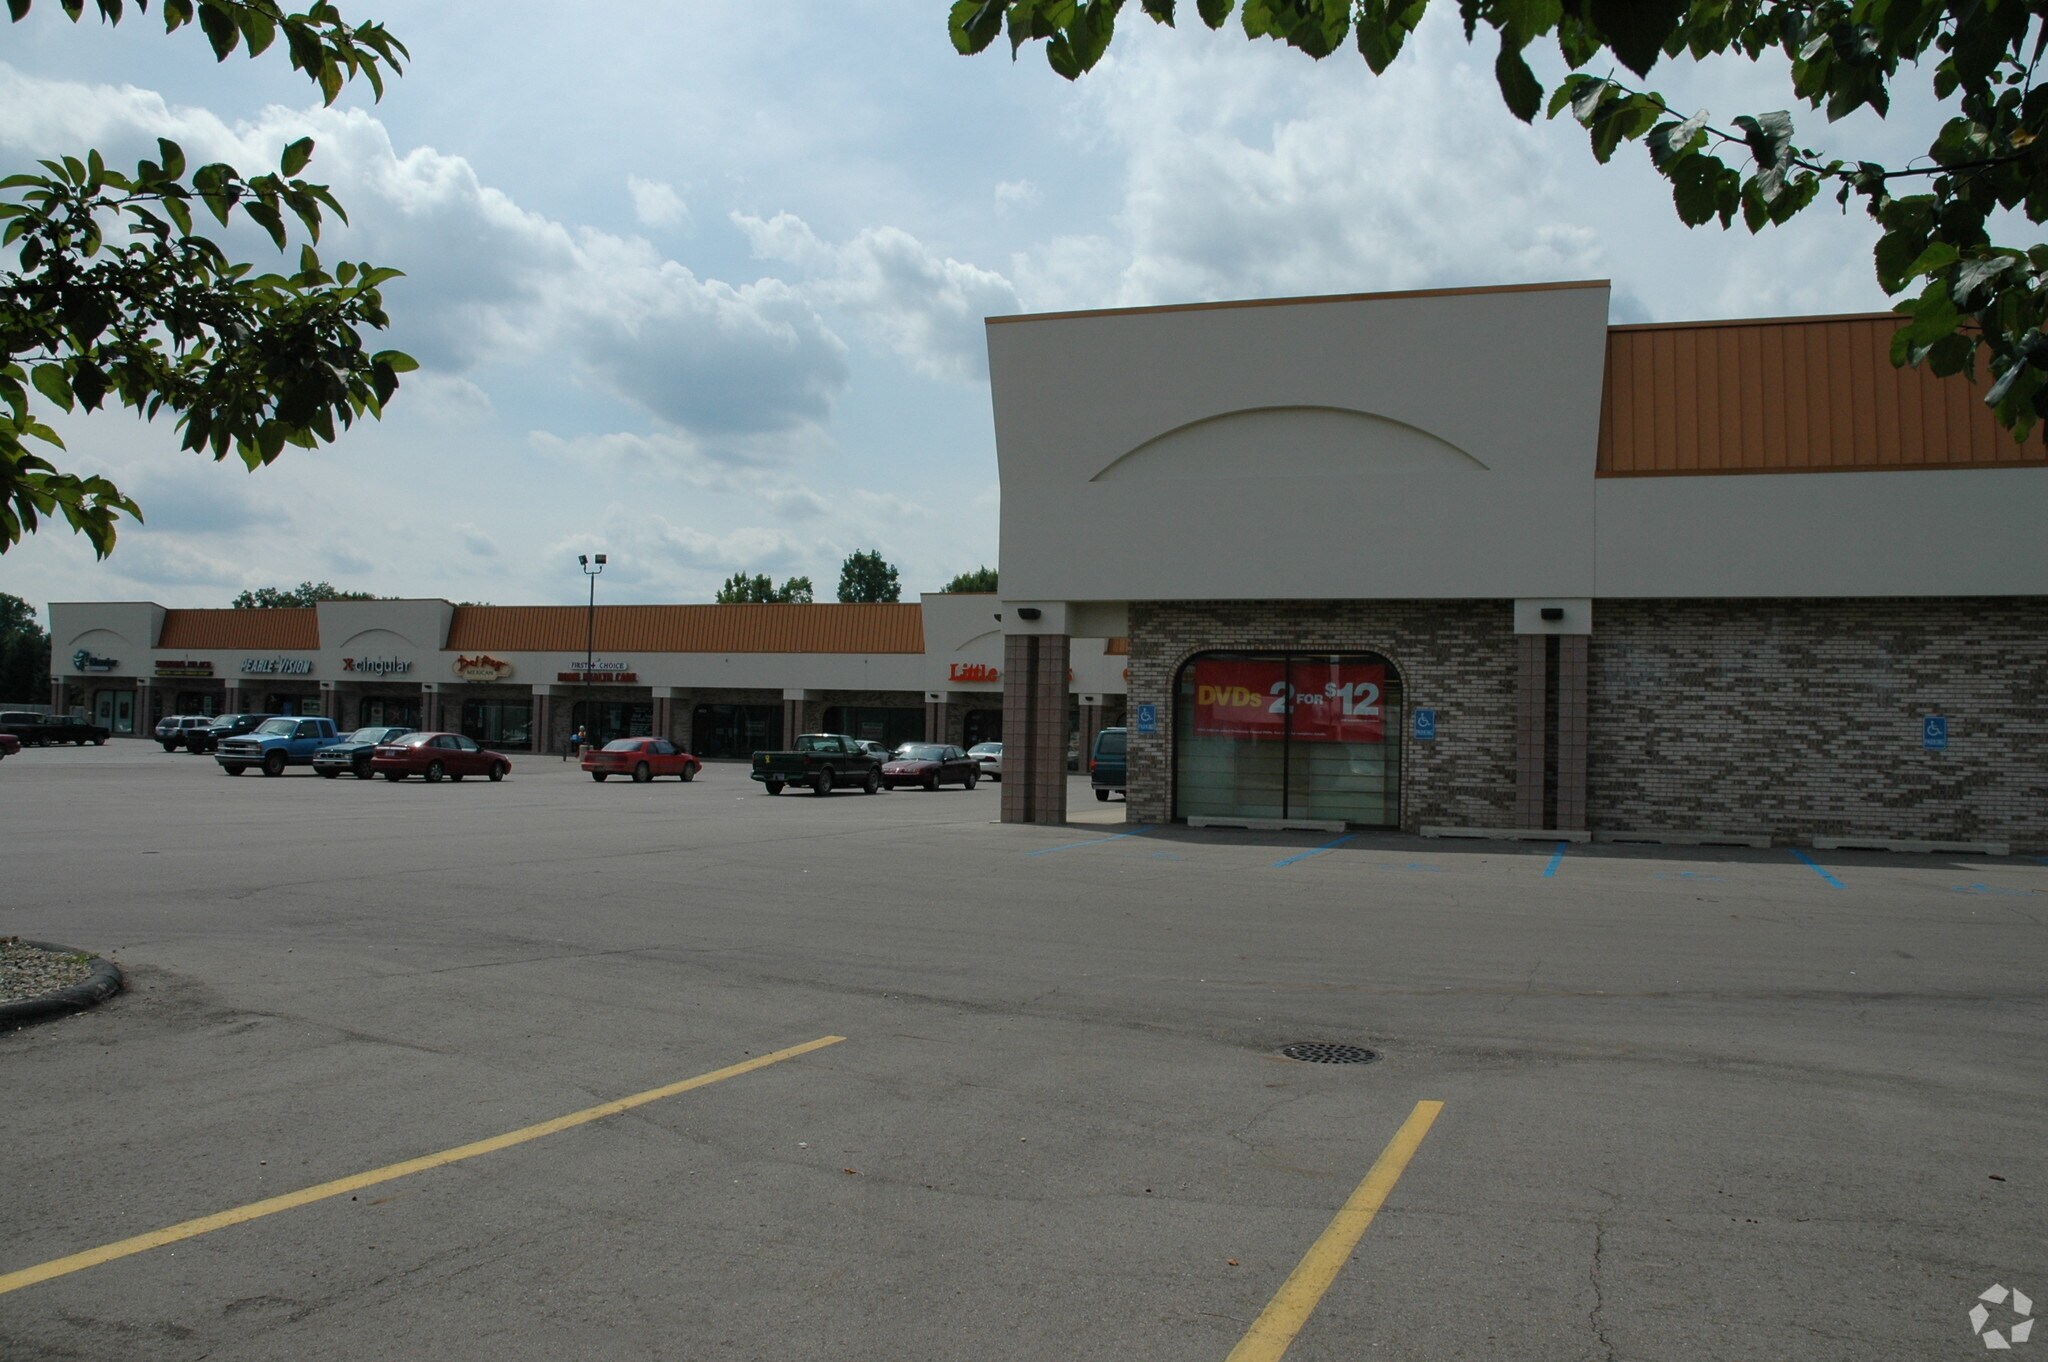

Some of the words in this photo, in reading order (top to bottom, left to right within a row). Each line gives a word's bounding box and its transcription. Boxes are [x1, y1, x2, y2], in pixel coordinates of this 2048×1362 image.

[240, 657, 275, 673] PEARLE
[277, 657, 312, 674] VISION
[355, 655, 412, 677] cingular
[571, 661, 589, 669] FIRST
[599, 661, 624, 669] CHOICE
[948, 663, 998, 682] Little
[1198, 685, 1262, 708] DVDs
[1268, 681, 1294, 714] 2
[1296, 693, 1324, 705] FOR
[1324, 682, 1380, 716] $12
